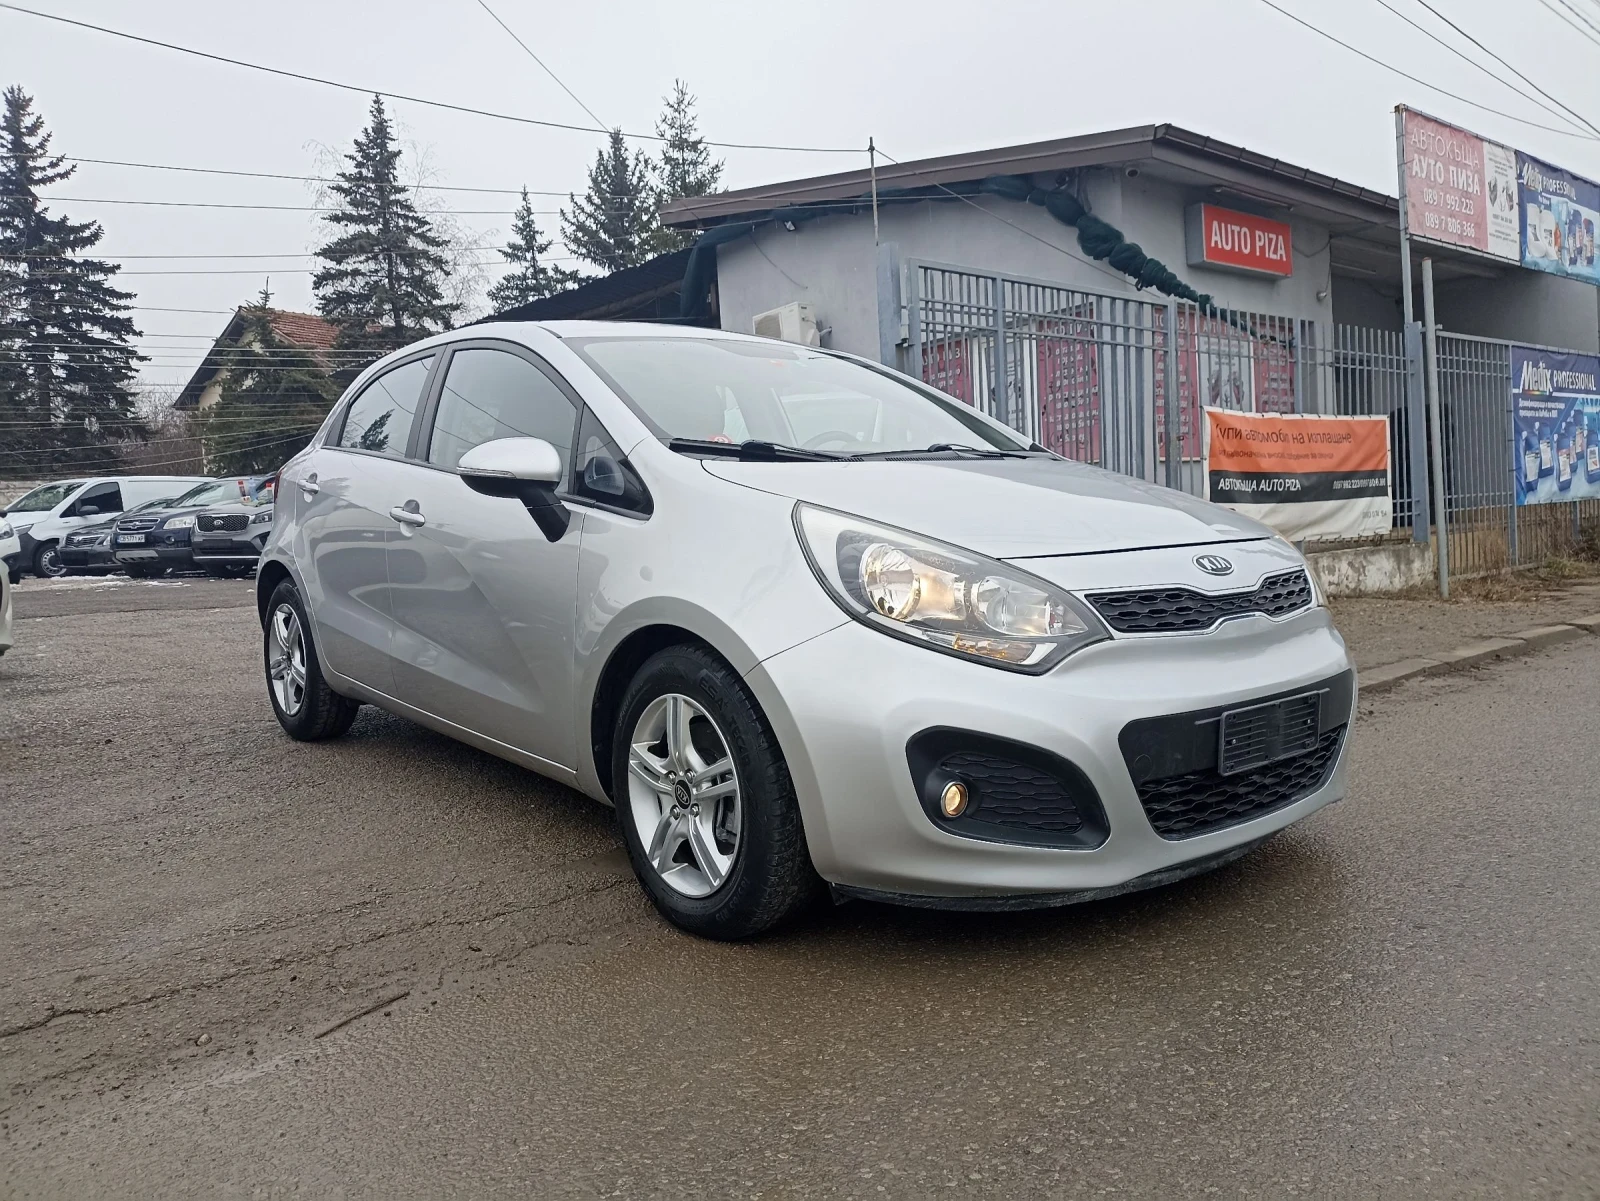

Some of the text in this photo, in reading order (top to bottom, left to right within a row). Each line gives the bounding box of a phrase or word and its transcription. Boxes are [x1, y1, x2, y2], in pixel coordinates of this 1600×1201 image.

[1410, 128, 1480, 170] АВТОКЪЩА
[1412, 153, 1481, 196] АУТО ПИЗА
[1424, 187, 1474, 215] 089 7 992 223
[1425, 211, 1439, 229] 089
[1441, 215, 1446, 230] 7
[1448, 217, 1461, 234] 806
[1211, 220, 1286, 261] AUTO PIZA
[1520, 360, 1597, 395] Medix PROFESSIONAL
[1292, 432, 1305, 444] на
[1218, 478, 1301, 493] АВТОКЪЩА AUTO PIZA
[1197, 556, 1232, 570] KIA
